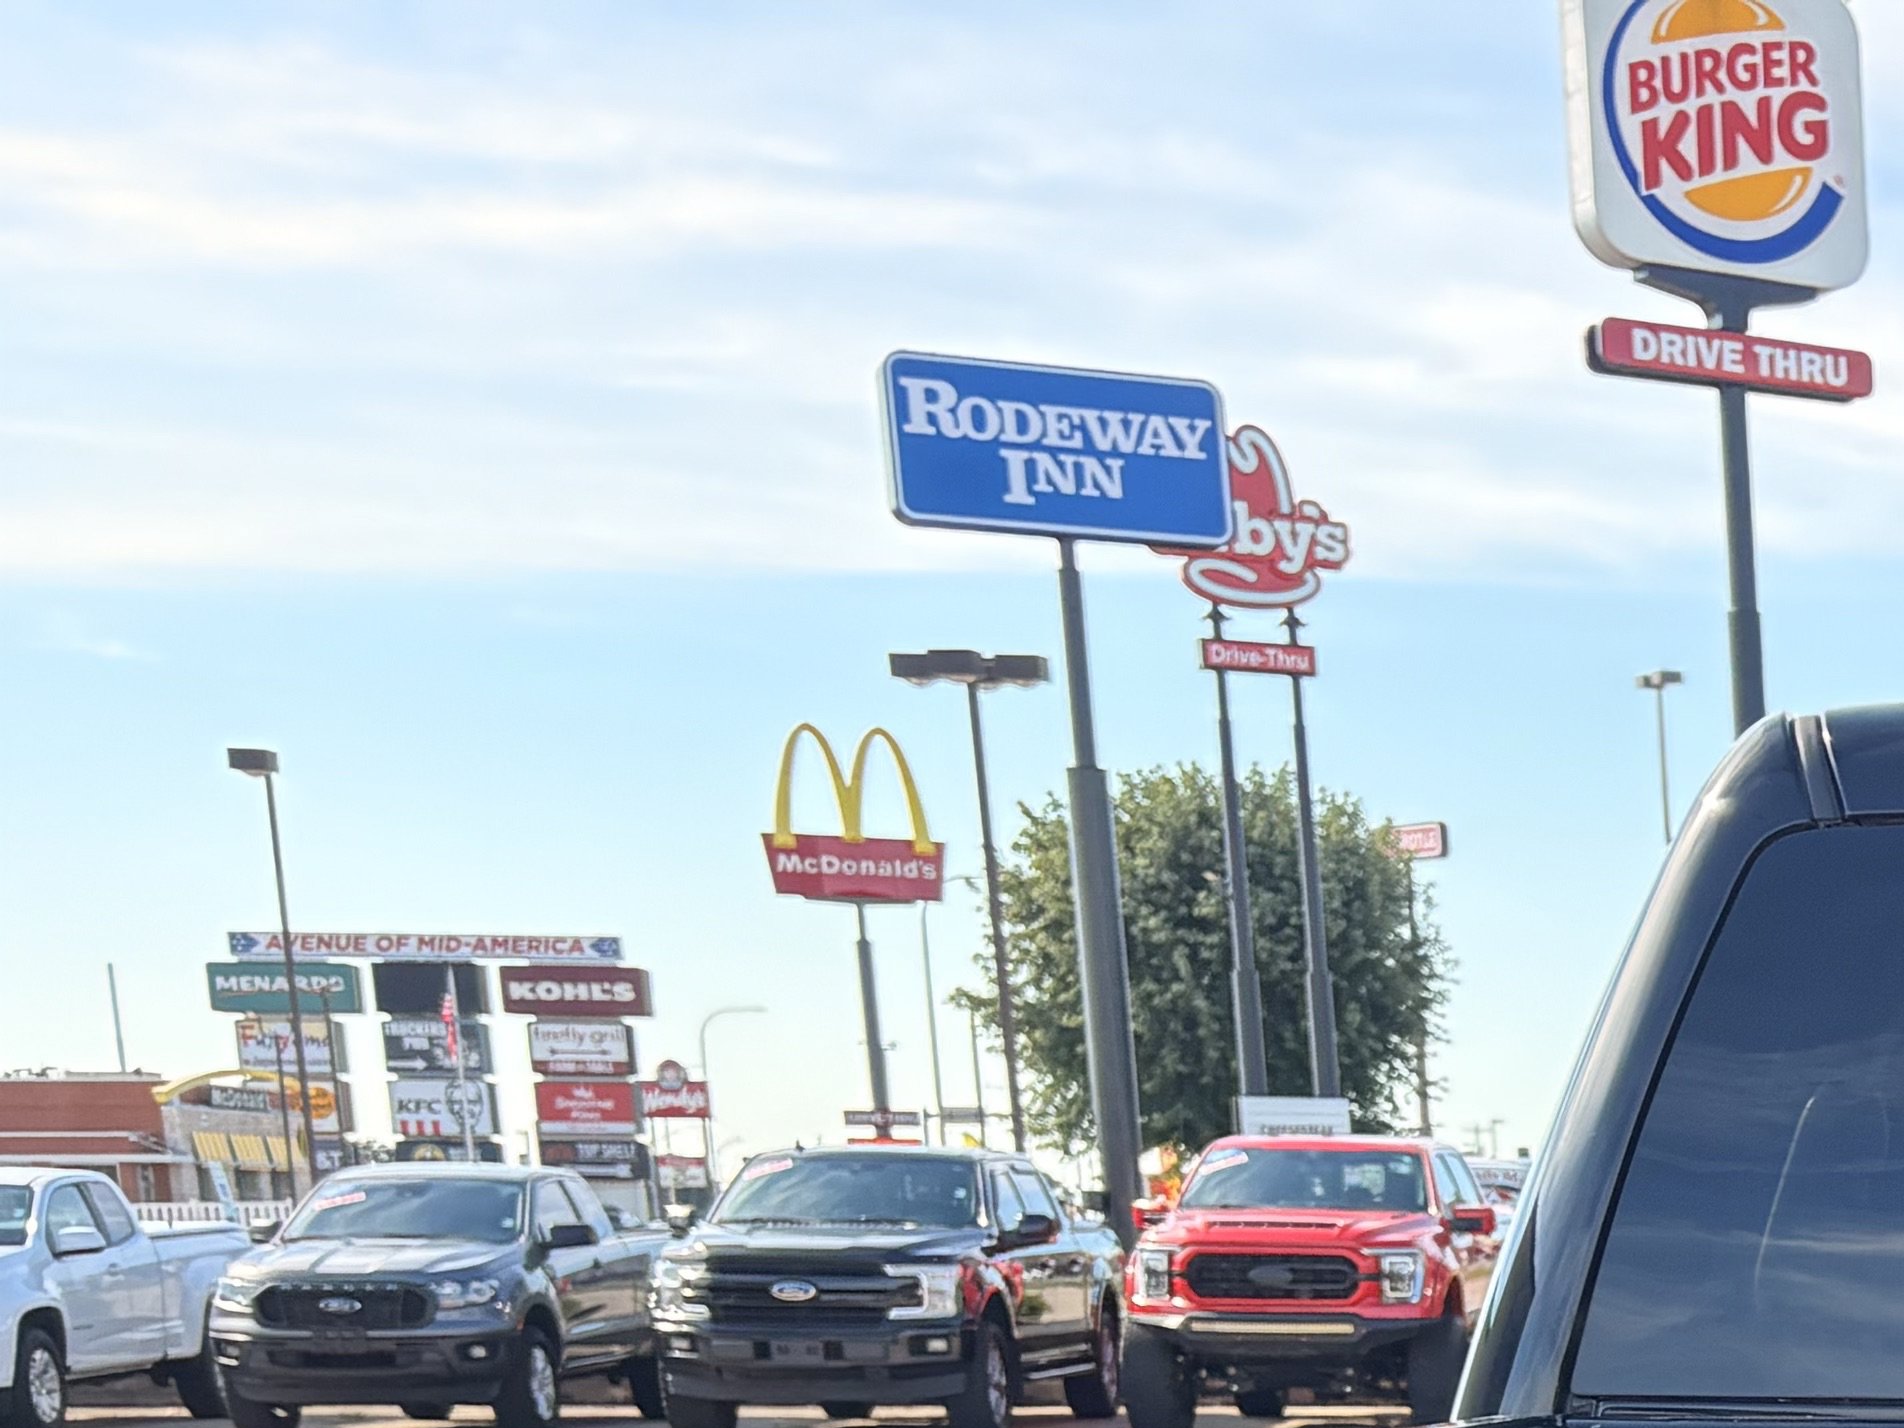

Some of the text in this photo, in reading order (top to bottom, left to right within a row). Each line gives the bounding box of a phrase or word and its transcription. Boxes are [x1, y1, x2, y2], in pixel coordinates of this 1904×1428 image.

[1627, 40, 1820, 115] BURGER
[1641, 90, 1830, 192] KING
[1631, 327, 1849, 387] DRIVE THRU
[897, 376, 1212, 460] RODEWAY
[999, 448, 1124, 506] INN
[1211, 643, 1310, 669] Drive-Thru
[776, 853, 938, 880] McDonald's
[375, 935, 411, 953] OF
[417, 935, 585, 956] MID-AMERICA
[508, 979, 637, 1002] KOHL'S
[397, 1098, 442, 1115] KFC
